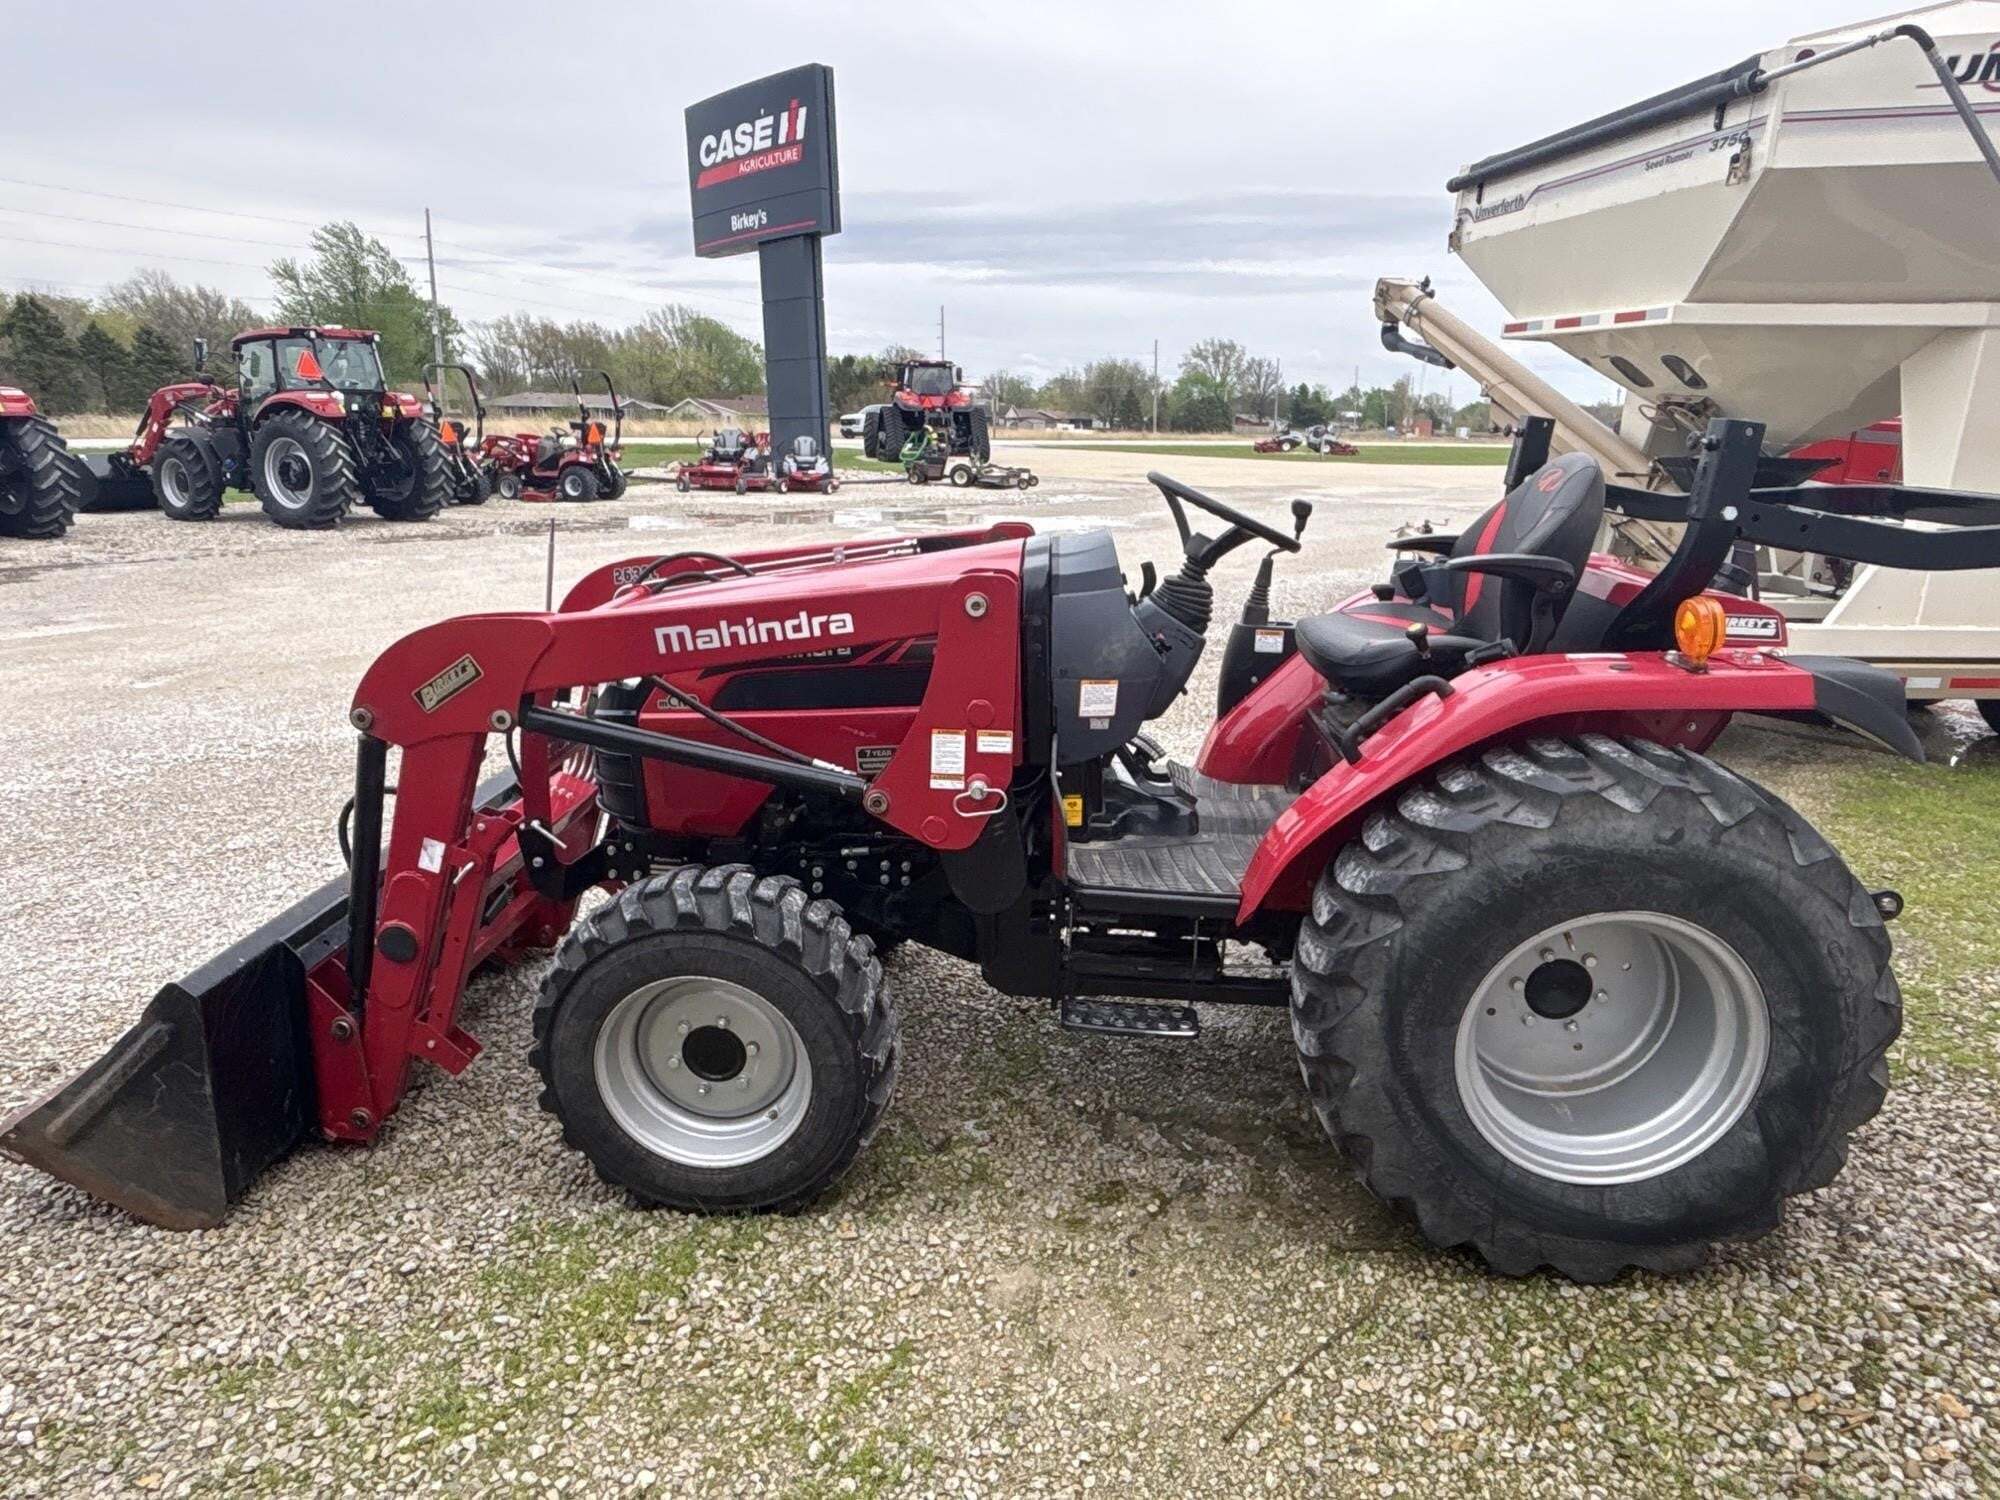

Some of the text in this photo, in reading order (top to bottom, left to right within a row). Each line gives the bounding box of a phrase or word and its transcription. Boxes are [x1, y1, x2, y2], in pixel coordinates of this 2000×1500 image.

[700, 114, 775, 167] CASE
[738, 147, 799, 175] AGRICULTURE
[1644, 150, 1694, 172] Seed Runner
[730, 208, 768, 232] Birkey's
[653, 610, 855, 655] Mahindra
[1724, 616, 1778, 629] IRKEY'S
[865, 749, 892, 758] 7 YEAR
